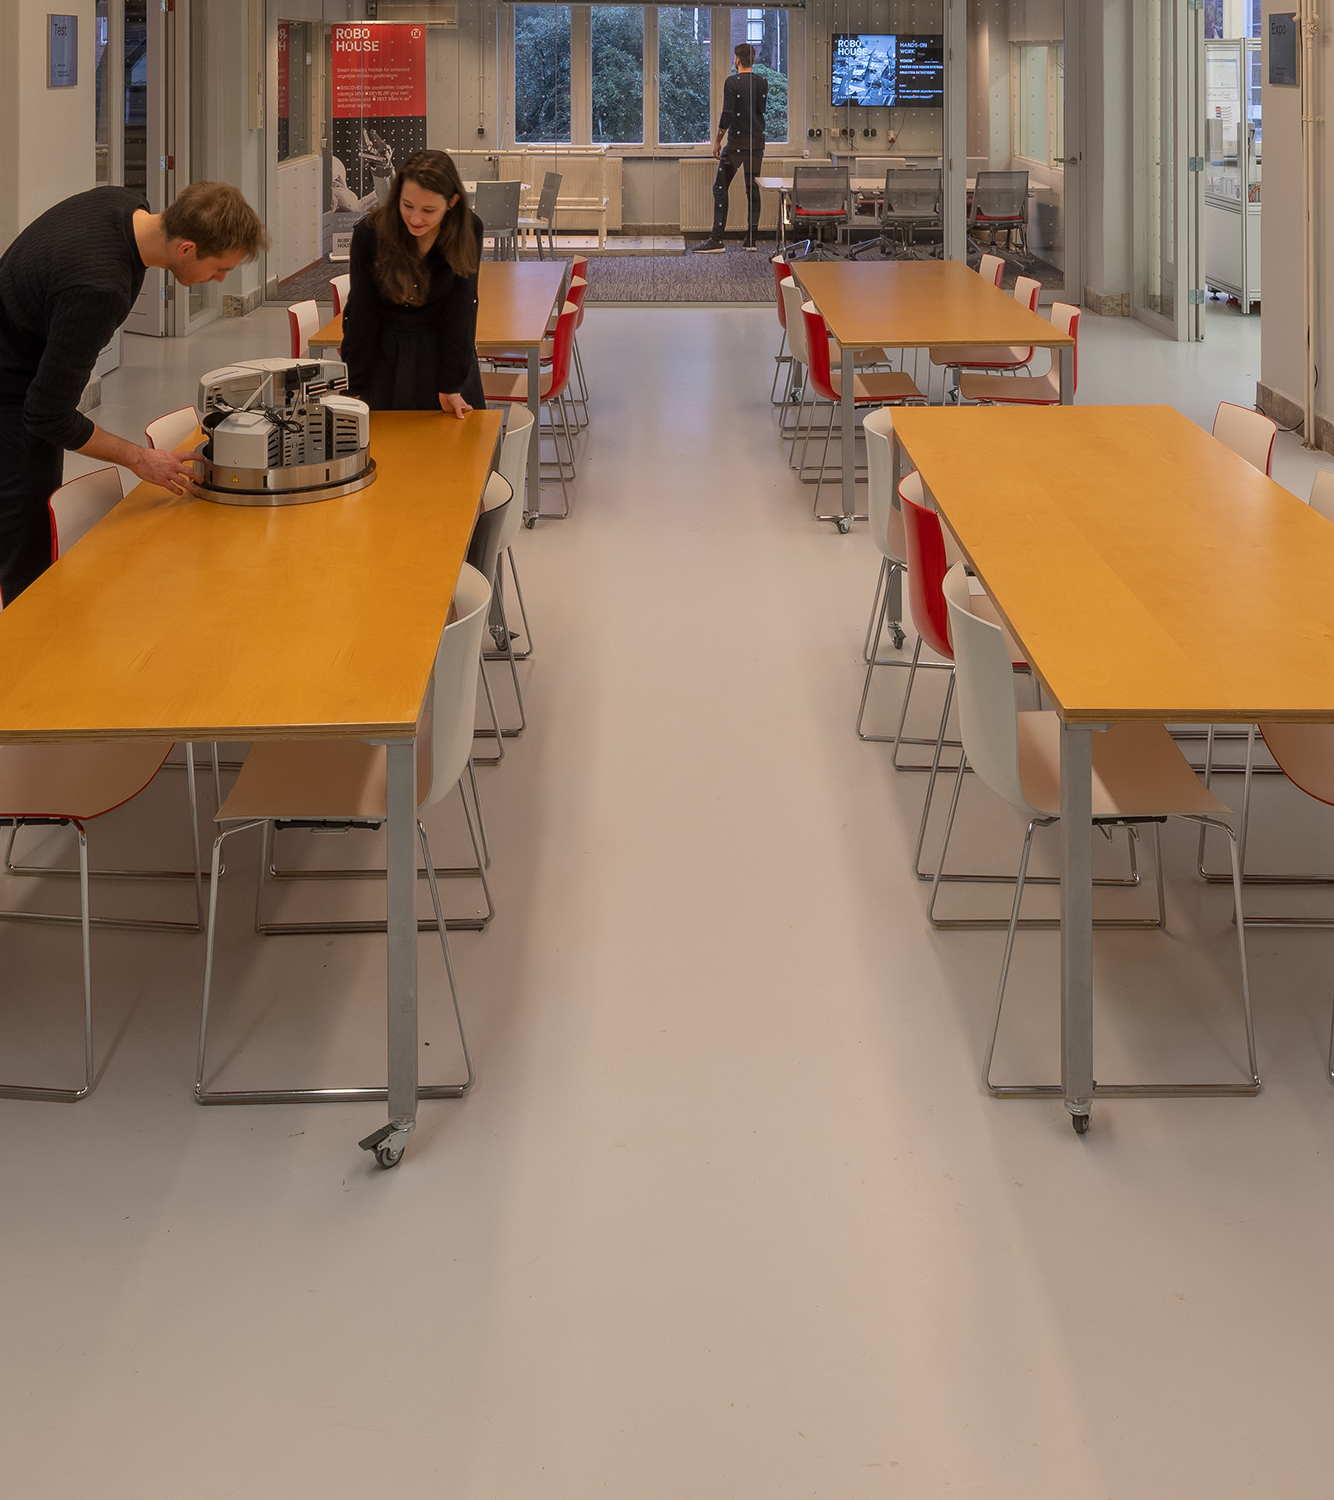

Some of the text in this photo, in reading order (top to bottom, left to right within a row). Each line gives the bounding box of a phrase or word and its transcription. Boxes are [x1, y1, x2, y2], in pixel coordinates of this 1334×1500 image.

[54, 23, 68, 36] Test
[336, 28, 370, 39] ROBO
[1271, 22, 1287, 37] Expo
[336, 40, 380, 52] HOUSE
[837, 40, 862, 48] ROBO
[837, 48, 868, 56] HOUSE
